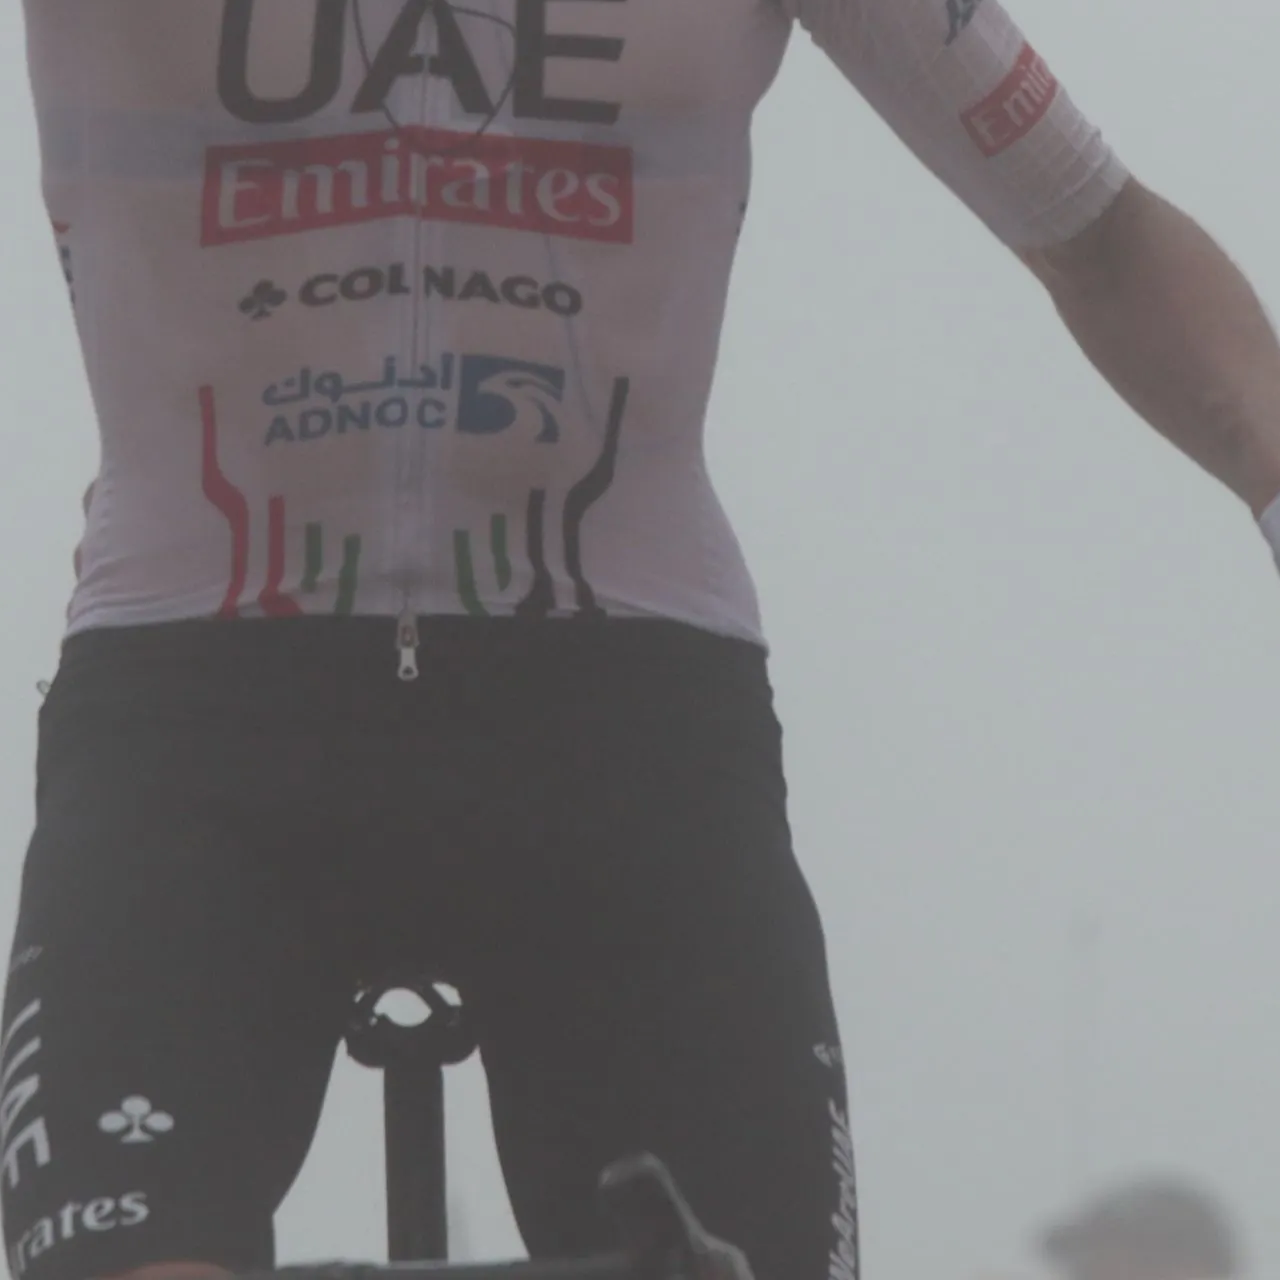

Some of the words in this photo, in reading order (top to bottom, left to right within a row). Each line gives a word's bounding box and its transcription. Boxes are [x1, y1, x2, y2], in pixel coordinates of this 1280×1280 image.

[219, 137, 621, 229] Emirates
[297, 261, 584, 319] COLNAGO
[263, 395, 448, 447] ADNOC
